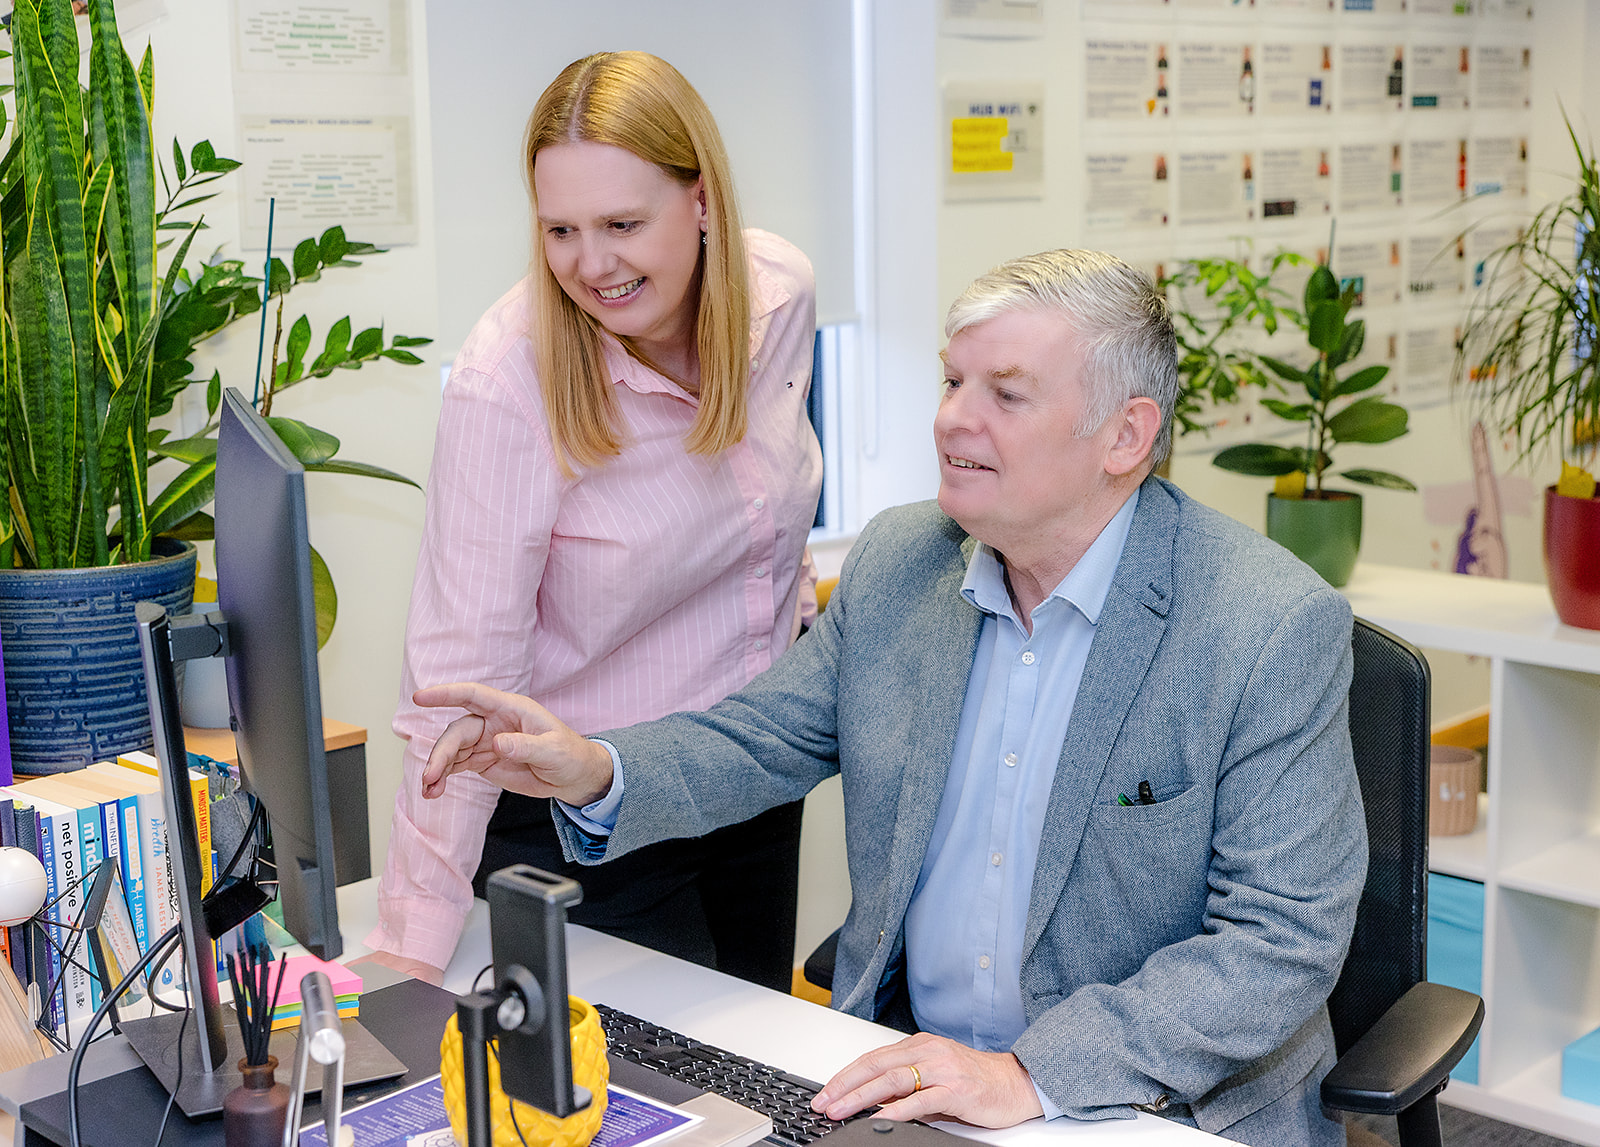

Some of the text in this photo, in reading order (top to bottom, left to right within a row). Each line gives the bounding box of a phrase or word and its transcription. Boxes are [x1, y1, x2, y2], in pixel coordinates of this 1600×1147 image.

[126, 810, 137, 839] WHY
[198, 789, 208, 844] MINDSET MATTERS
[44, 841, 52, 859] THE
[61, 822, 73, 847] net
[110, 827, 118, 856] INFLU
[83, 822, 102, 890] mindse
[46, 861, 55, 894] POWER
[155, 866, 168, 936] JAMES NESTO
[50, 911, 60, 957] MMENTS
[134, 903, 145, 939] JAMES
